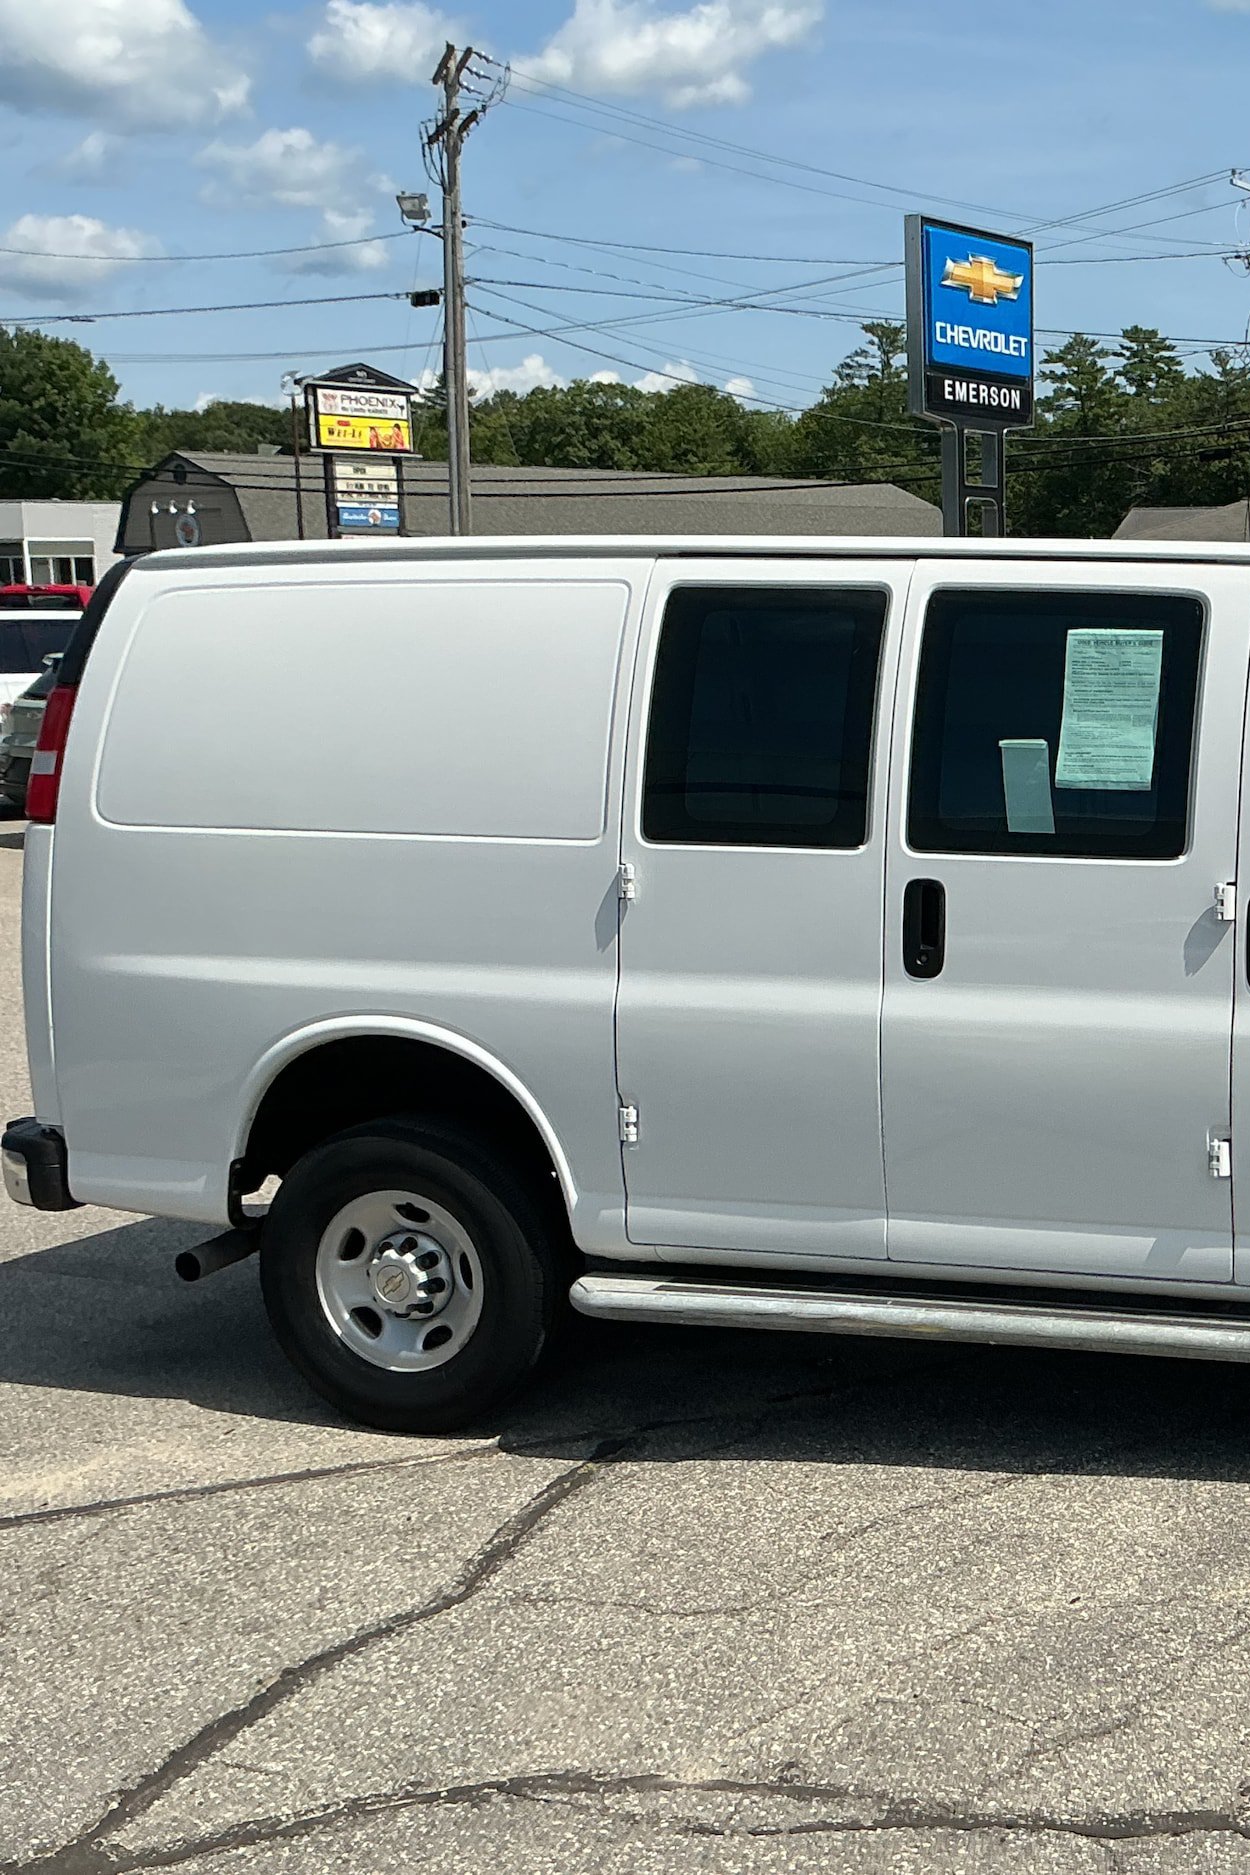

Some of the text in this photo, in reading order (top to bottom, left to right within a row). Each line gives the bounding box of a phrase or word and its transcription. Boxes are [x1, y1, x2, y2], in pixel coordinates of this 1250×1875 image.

[935, 321, 1028, 357] CHEVROLET
[340, 394, 397, 408] PHOENIX
[944, 379, 1021, 410] EMERSON
